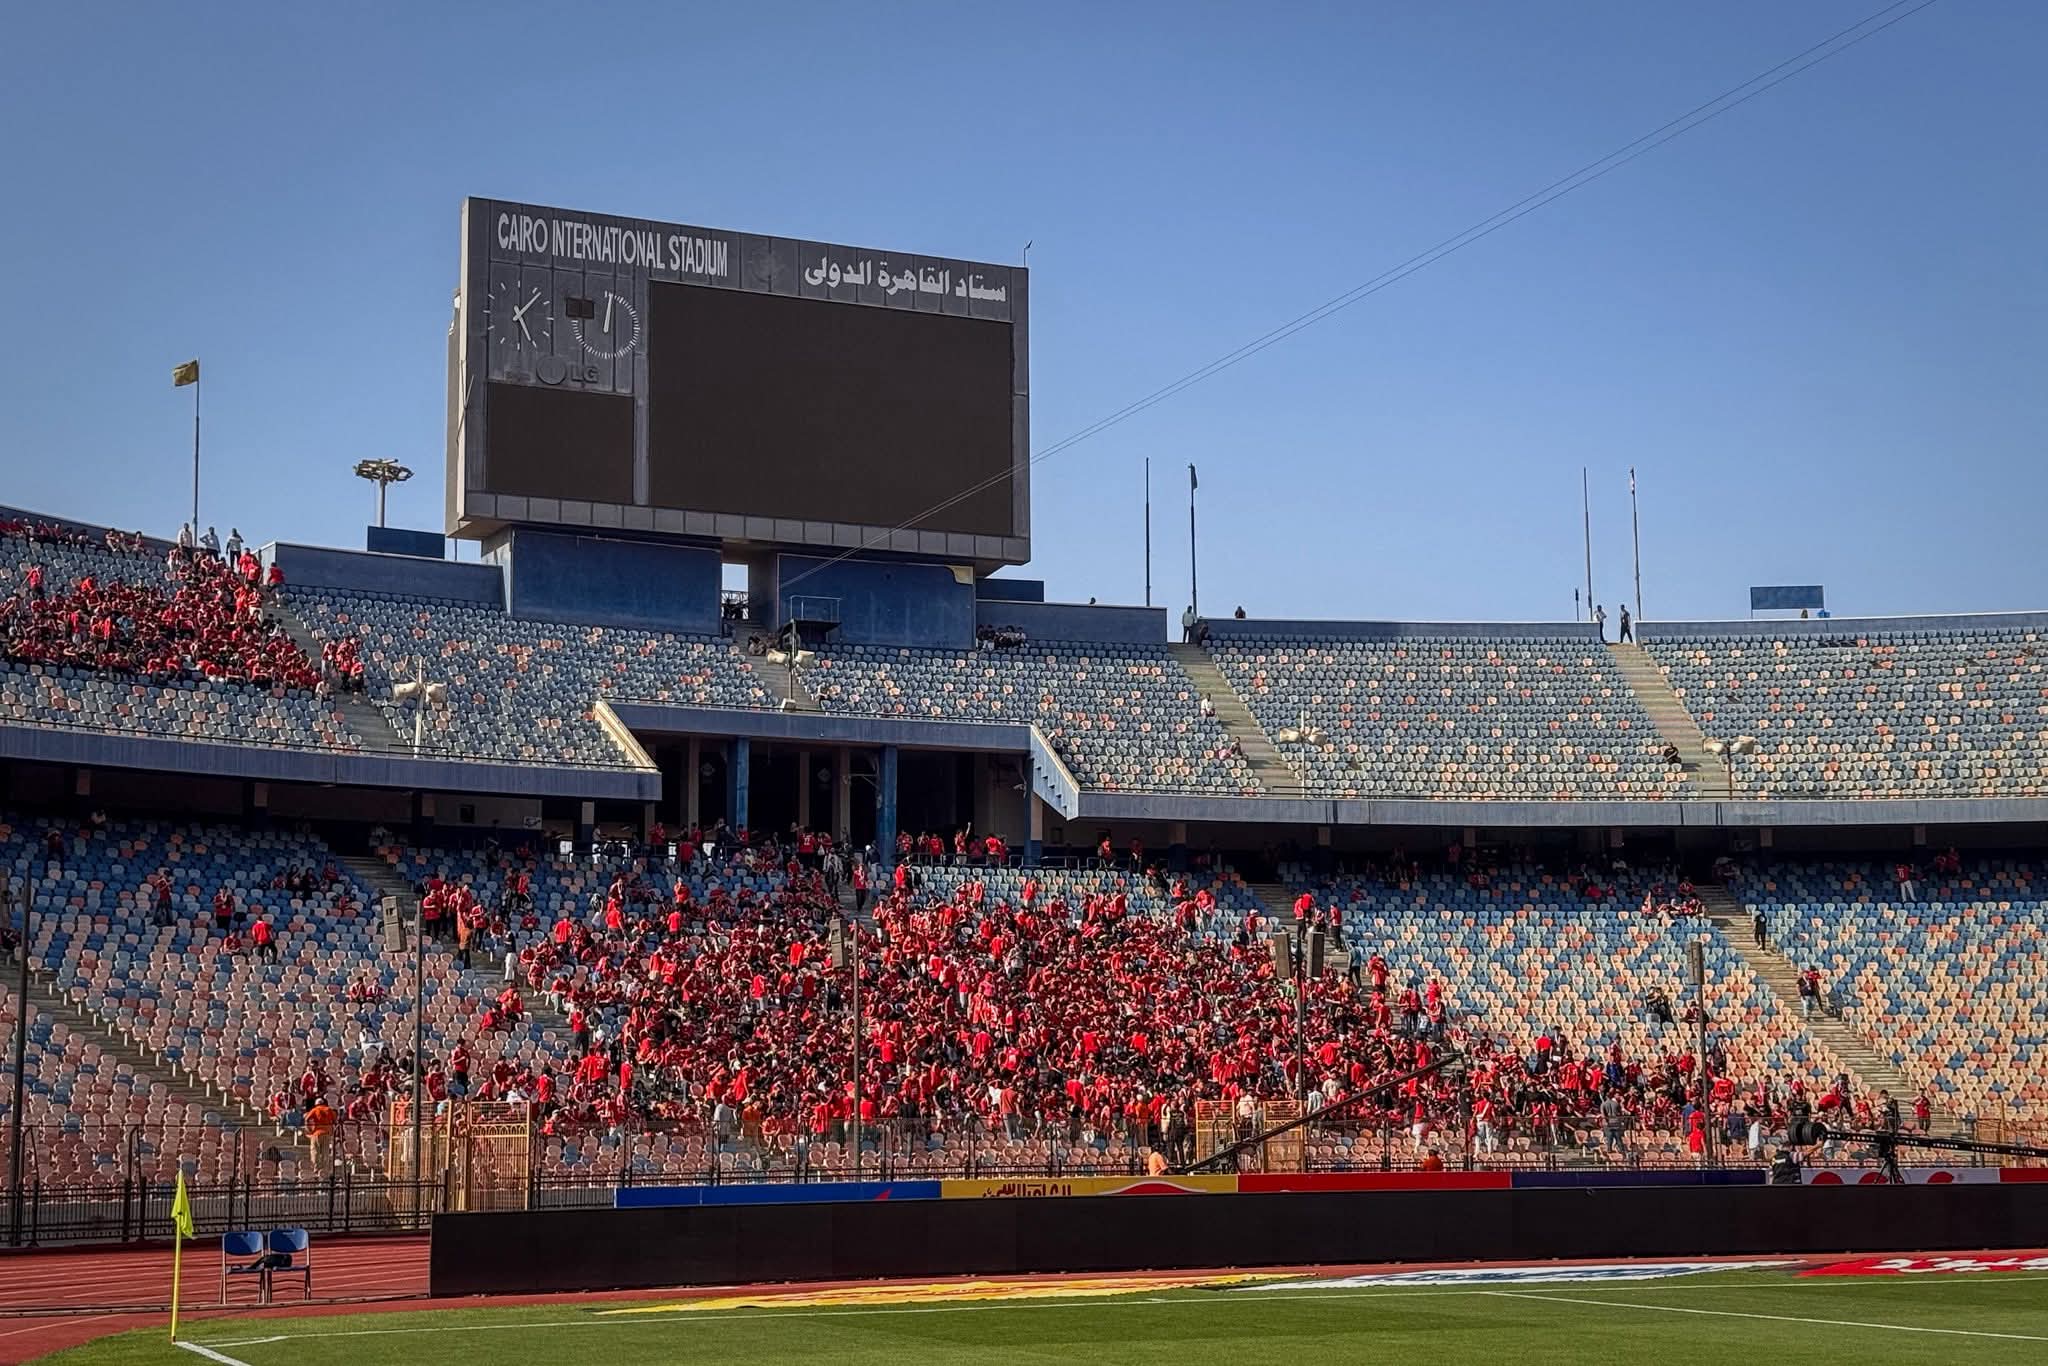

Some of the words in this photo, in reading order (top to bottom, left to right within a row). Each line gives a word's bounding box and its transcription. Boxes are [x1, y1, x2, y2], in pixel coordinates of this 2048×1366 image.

[498, 212, 548, 253] CAIRO
[552, 219, 665, 270] INTERNATIONAL
[668, 234, 728, 277] STADIUM
[804, 256, 872, 288] الدولى
[877, 261, 950, 296] القاهرة
[955, 274, 1006, 302] ستاد
[571, 362, 599, 384] LG
